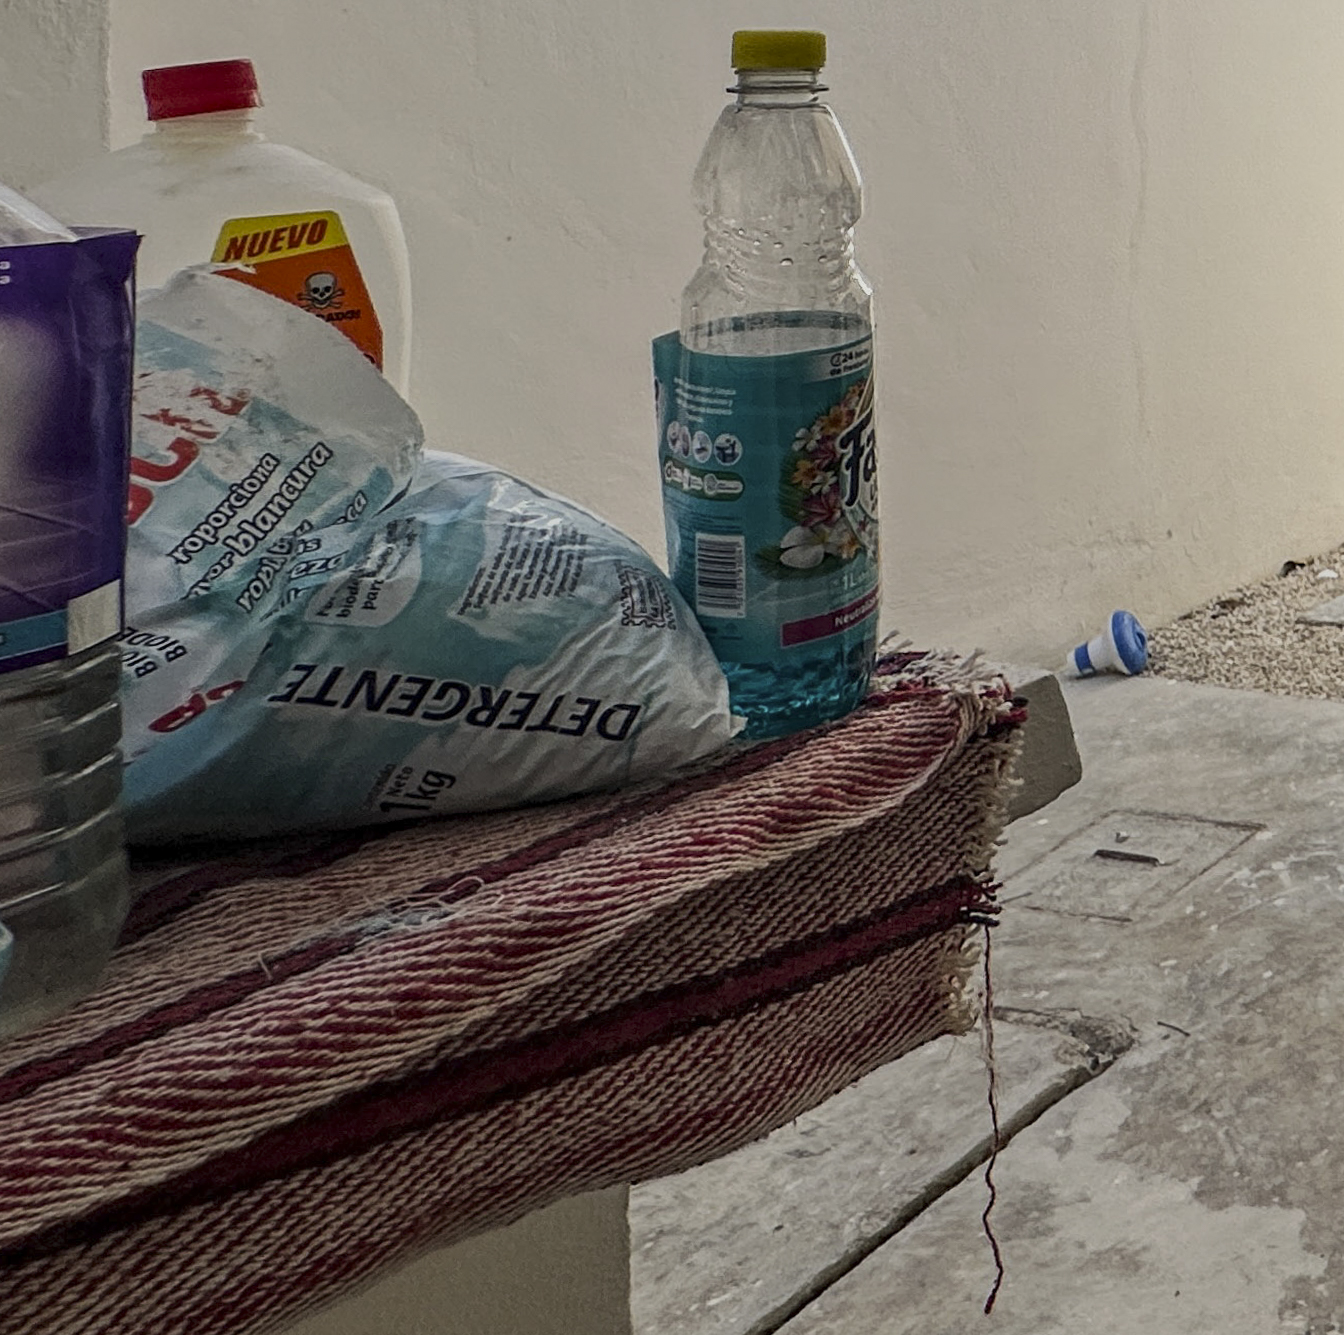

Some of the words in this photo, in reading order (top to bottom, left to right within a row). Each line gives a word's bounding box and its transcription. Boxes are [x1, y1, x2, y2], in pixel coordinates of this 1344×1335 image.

[222, 219, 329, 262] NUEVO
[167, 453, 280, 564] roporciona
[222, 441, 333, 557] blancura
[268, 663, 642, 741] DETERGENTE
